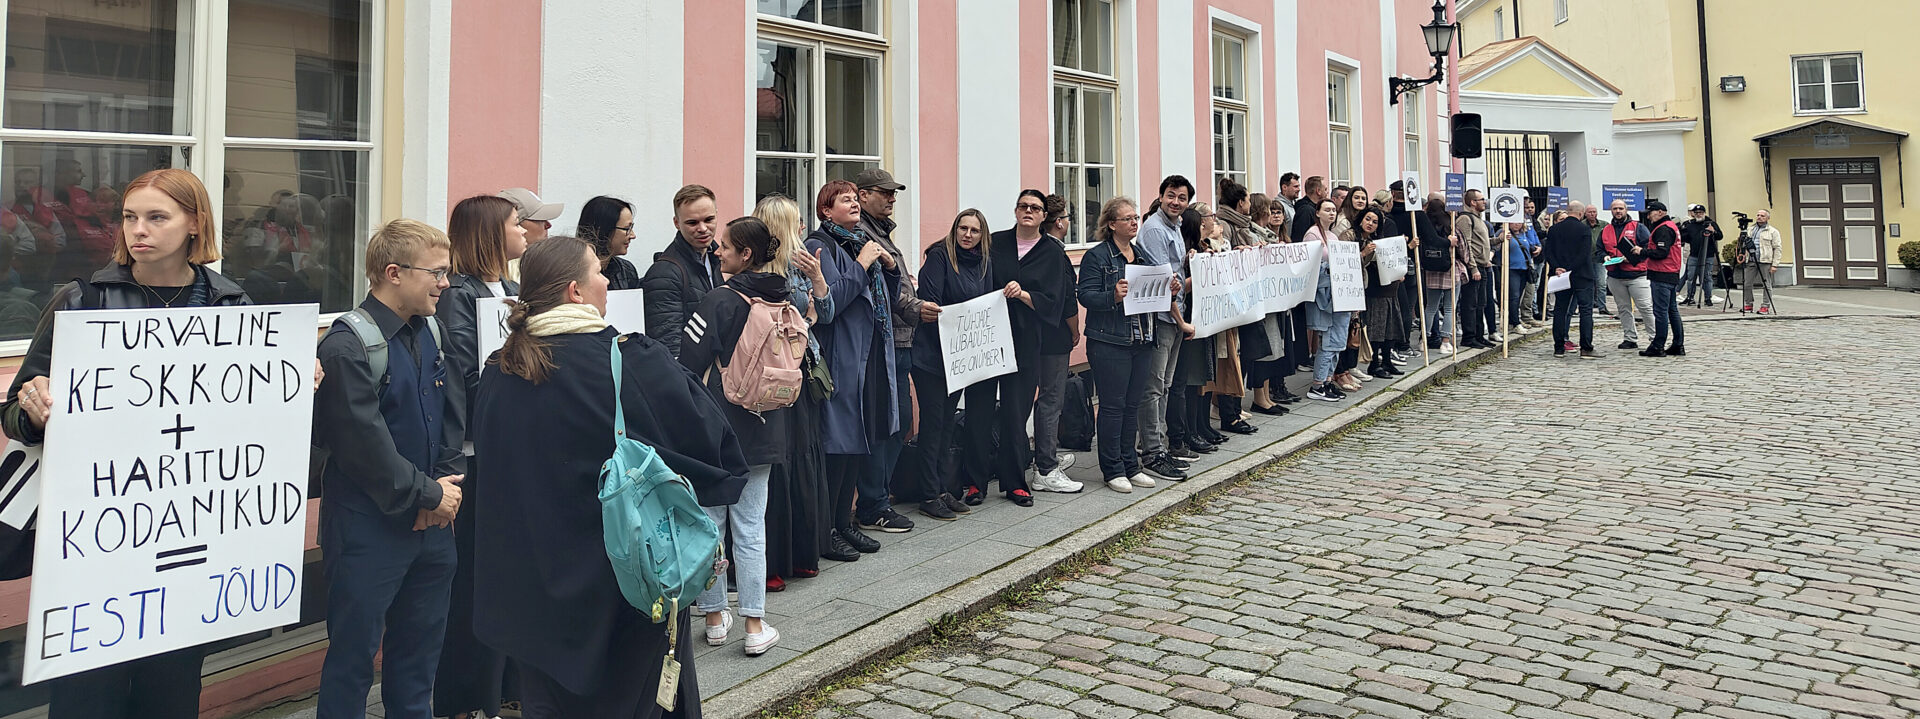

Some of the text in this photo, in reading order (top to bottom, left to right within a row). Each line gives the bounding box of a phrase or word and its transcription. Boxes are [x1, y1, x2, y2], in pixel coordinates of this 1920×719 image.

[86, 311, 282, 350] TURVALINE
[950, 325, 996, 354] LUBADUSTE
[66, 359, 302, 415] KESKKOND
[950, 357, 966, 376] AEG
[92, 443, 265, 498] HARITUD
[61, 481, 302, 560] KODANIKUD
[40, 562, 297, 660] EESTI JÕUD
